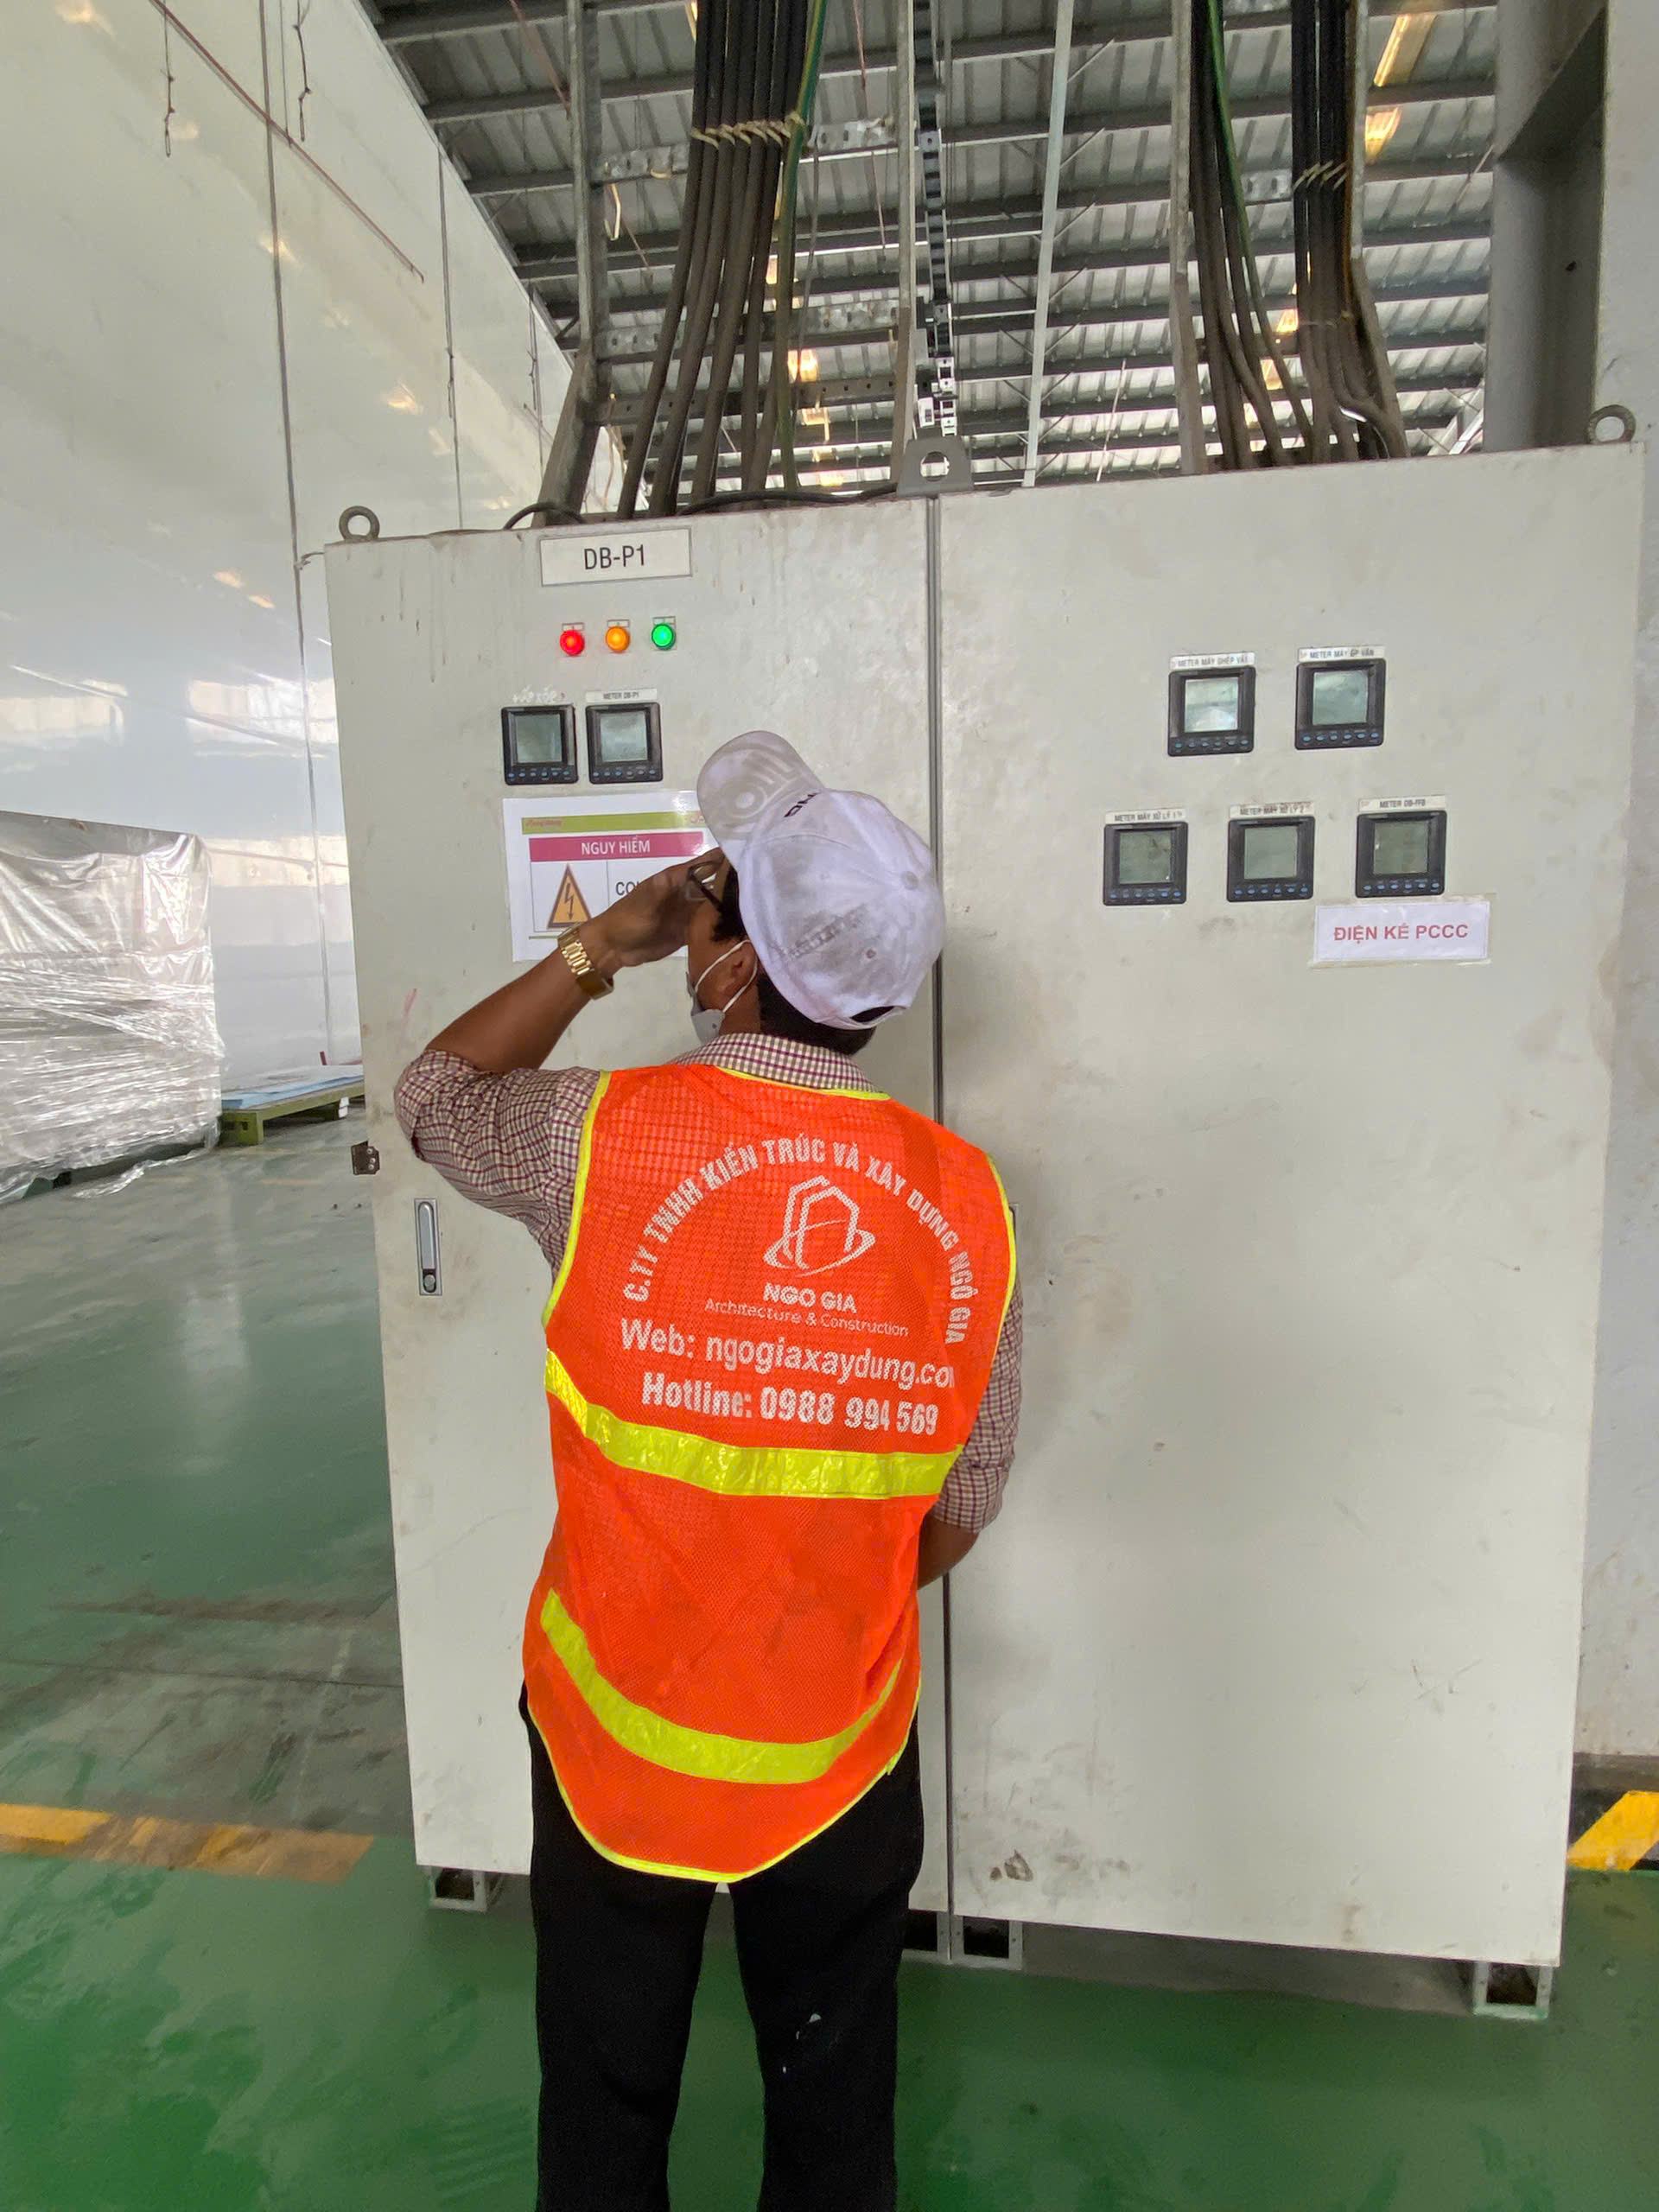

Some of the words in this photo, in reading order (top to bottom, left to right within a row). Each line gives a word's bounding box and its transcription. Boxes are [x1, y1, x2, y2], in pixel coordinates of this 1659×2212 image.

[584, 543, 644, 569] DB-P1
[582, 842, 615, 855] NGUY
[1334, 925, 1377, 944] ĐIỆN
[1416, 924, 1468, 939] PCCC
[763, 1282, 817, 1307] NGO
[821, 1291, 857, 1313] GIA
[621, 1317, 696, 1360] Web:
[641, 1370, 753, 1418] Hotline:
[760, 1386, 836, 1425] 0988
[896, 1401, 939, 1435] 569
